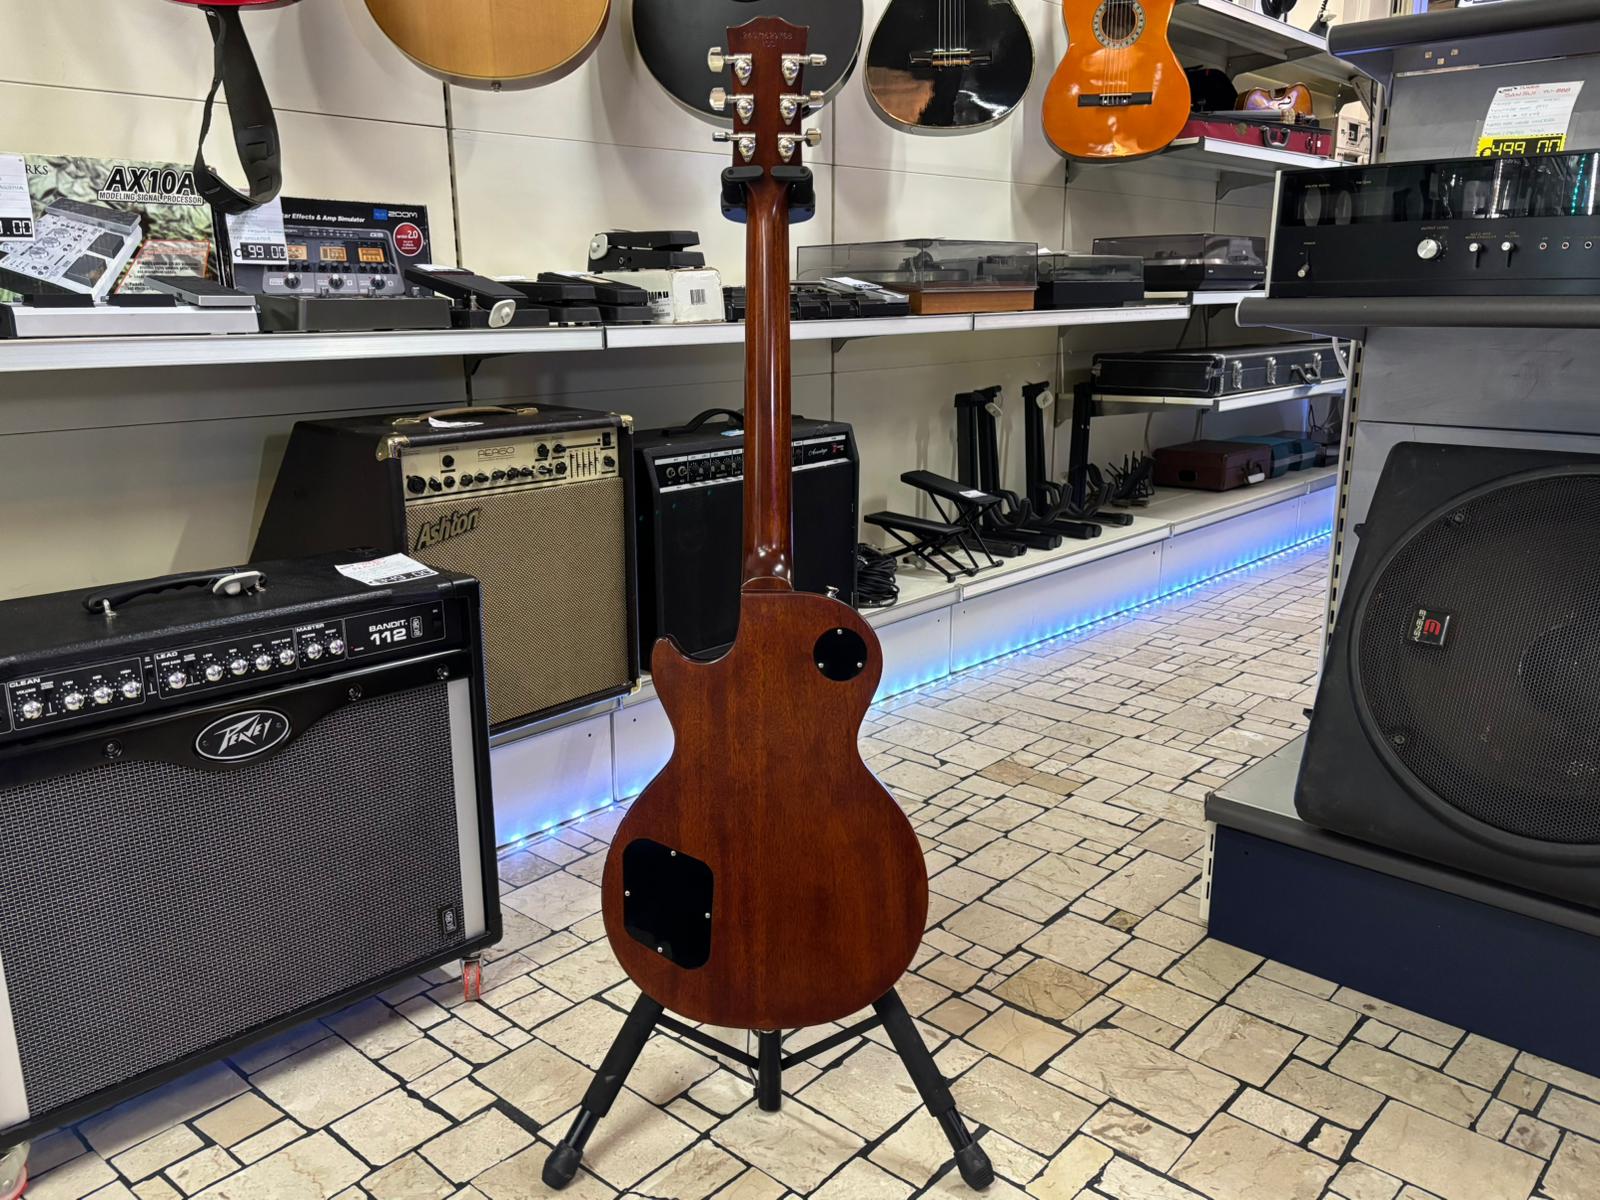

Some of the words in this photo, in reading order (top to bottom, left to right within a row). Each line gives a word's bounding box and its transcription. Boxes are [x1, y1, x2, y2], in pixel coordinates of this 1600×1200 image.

[25, 164, 49, 176] RKS
[104, 168, 197, 196] AX10A
[99, 192, 136, 201] MODELING
[137, 193, 161, 202] SIGNAL
[163, 195, 202, 204] PROCESSOR
[0, 219, 34, 236] .00
[407, 230, 419, 239] 2.0
[414, 507, 481, 551] Ashton
[296, 623, 325, 633] MASTER
[368, 619, 406, 633] BANDIT
[370, 627, 407, 646] 112
[156, 651, 178, 660] LEAD
[9, 678, 41, 688] CLEAN
